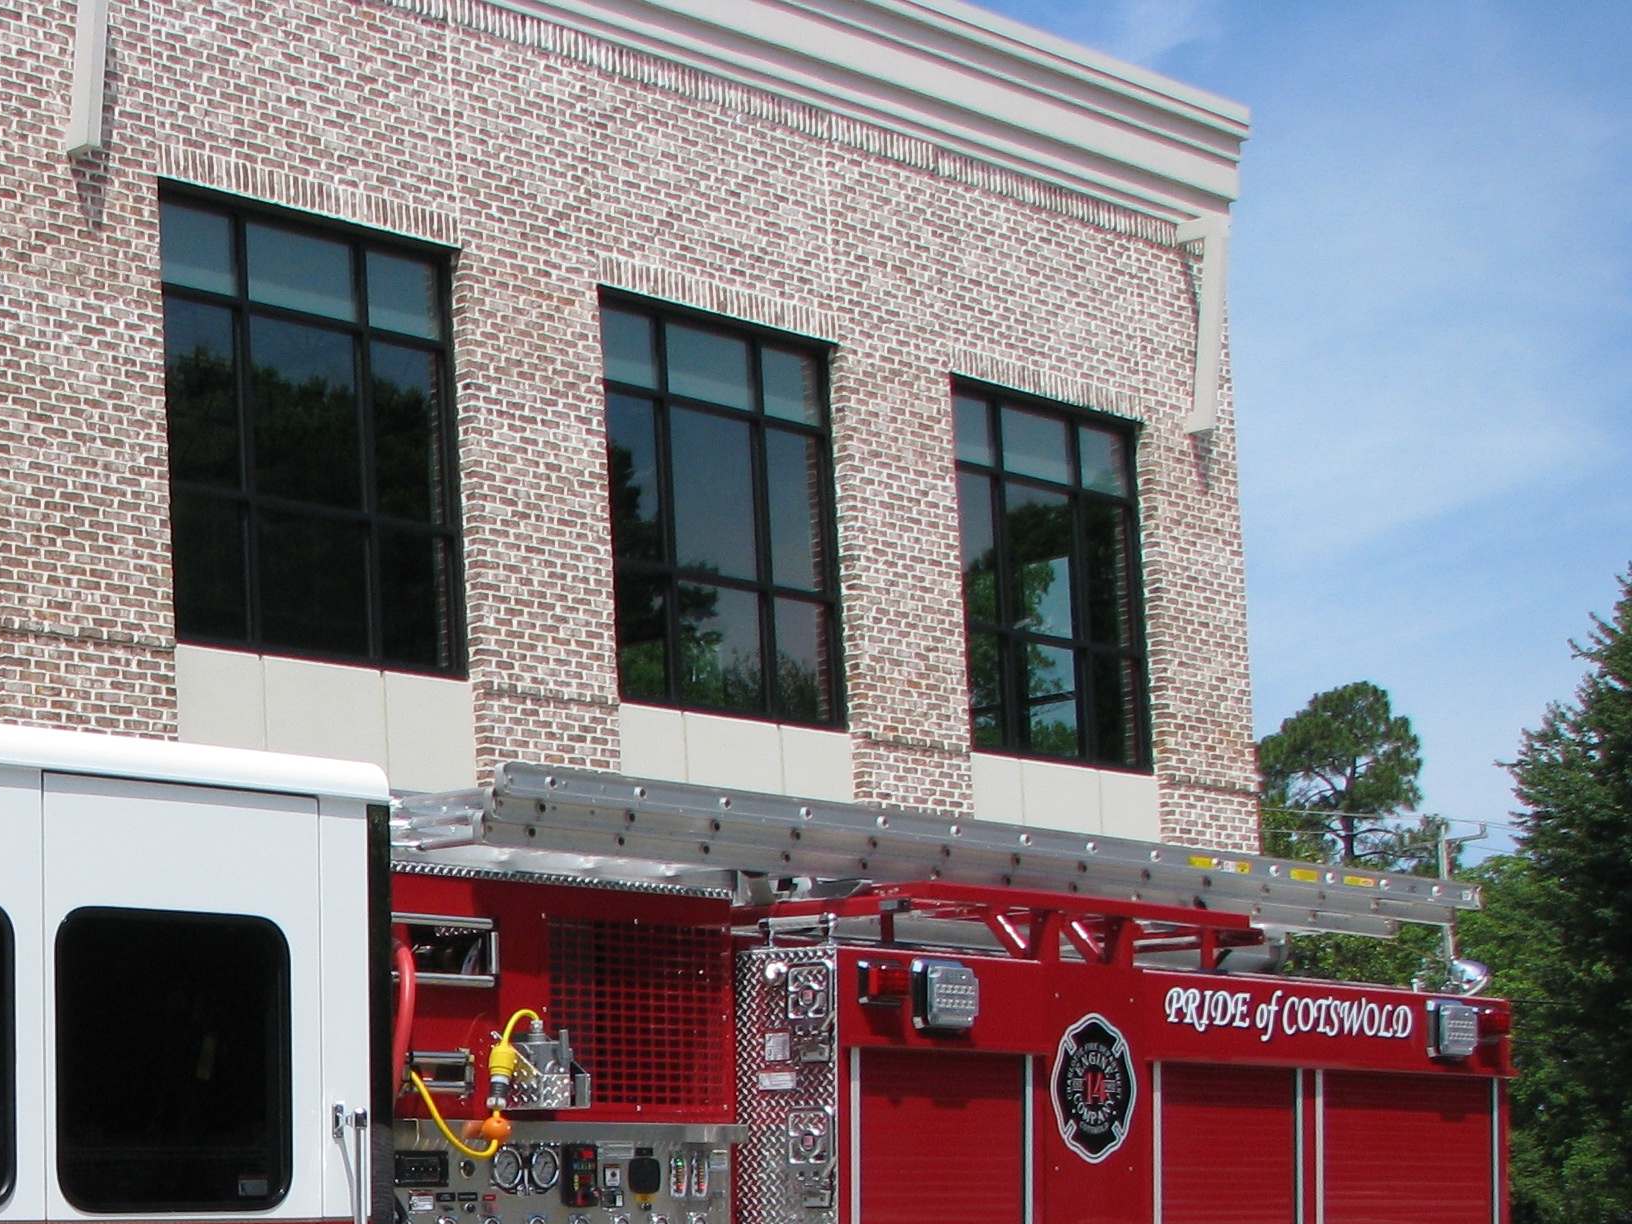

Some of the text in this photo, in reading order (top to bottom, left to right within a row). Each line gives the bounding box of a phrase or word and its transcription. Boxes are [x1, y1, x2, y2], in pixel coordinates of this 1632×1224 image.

[1165, 986, 1413, 1042] PRIDE of COTSWOLD
[1084, 1072, 1107, 1105] 14
